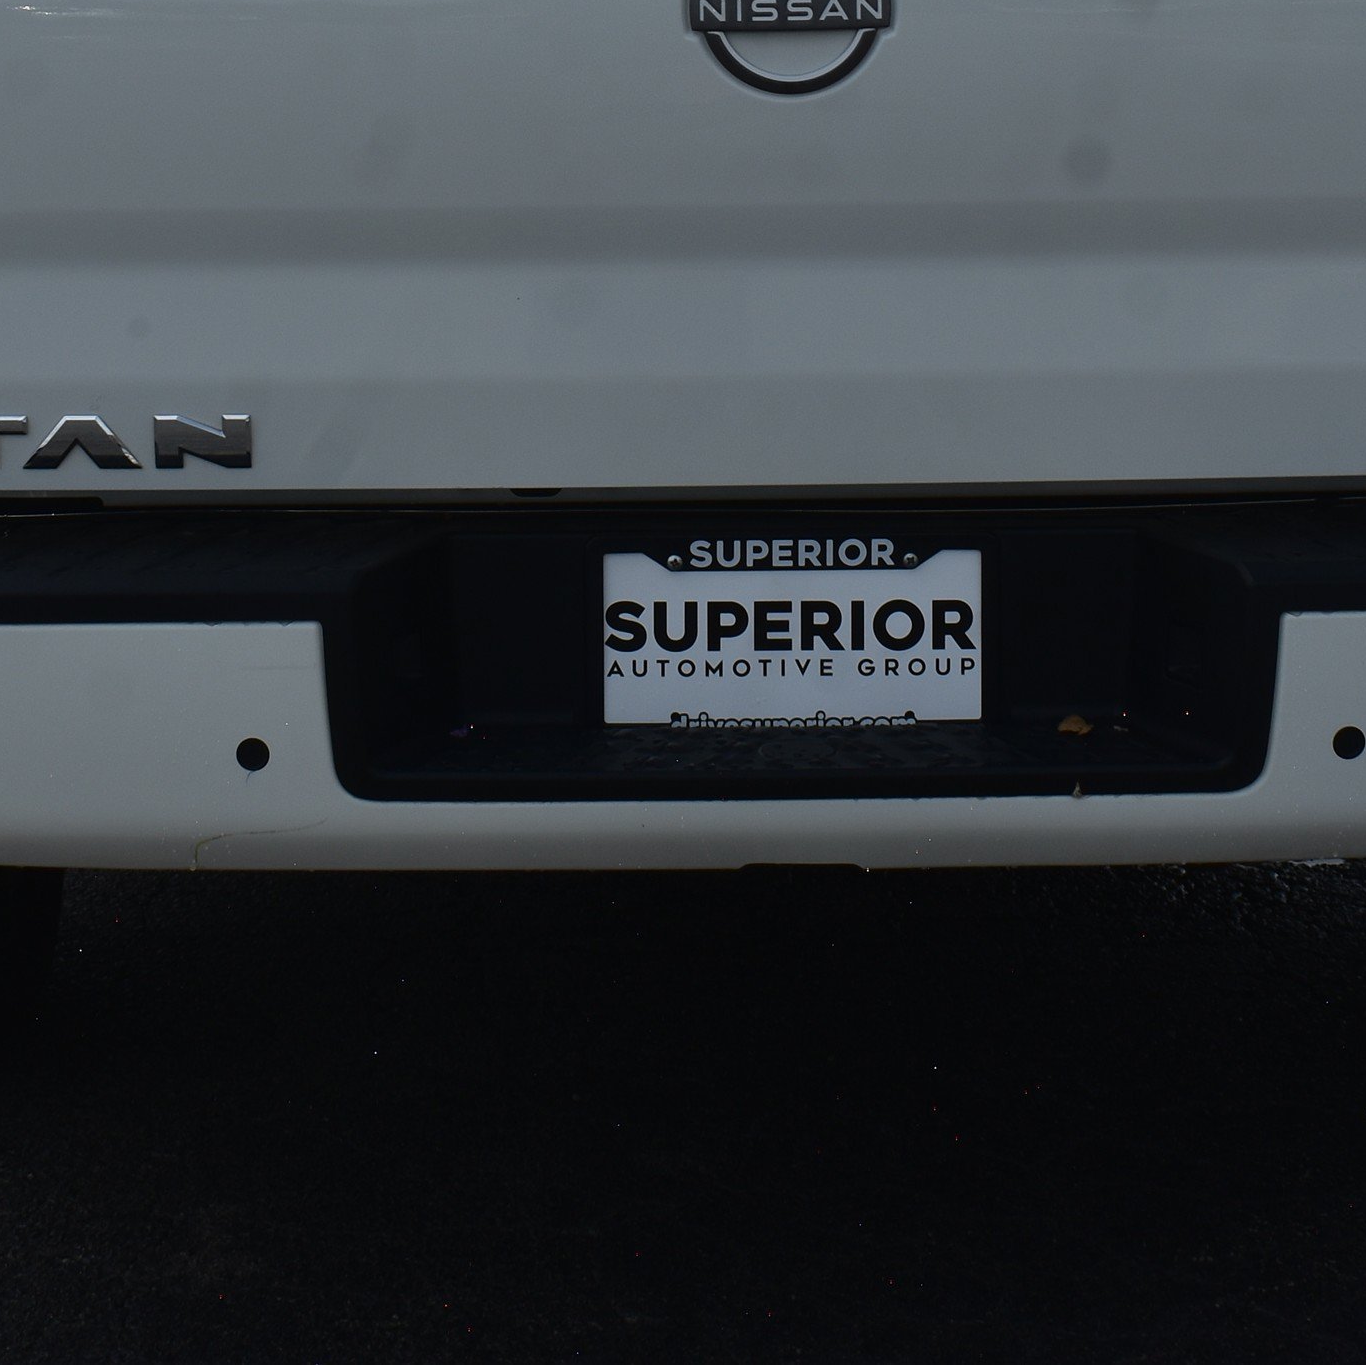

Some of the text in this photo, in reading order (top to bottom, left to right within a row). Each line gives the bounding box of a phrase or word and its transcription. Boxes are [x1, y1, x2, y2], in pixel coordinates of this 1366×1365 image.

[689, 538, 895, 569] SUPERIOR
[604, 599, 977, 653] SUPERIOR
[606, 657, 977, 678] AUTOMOTIVE GROUP
